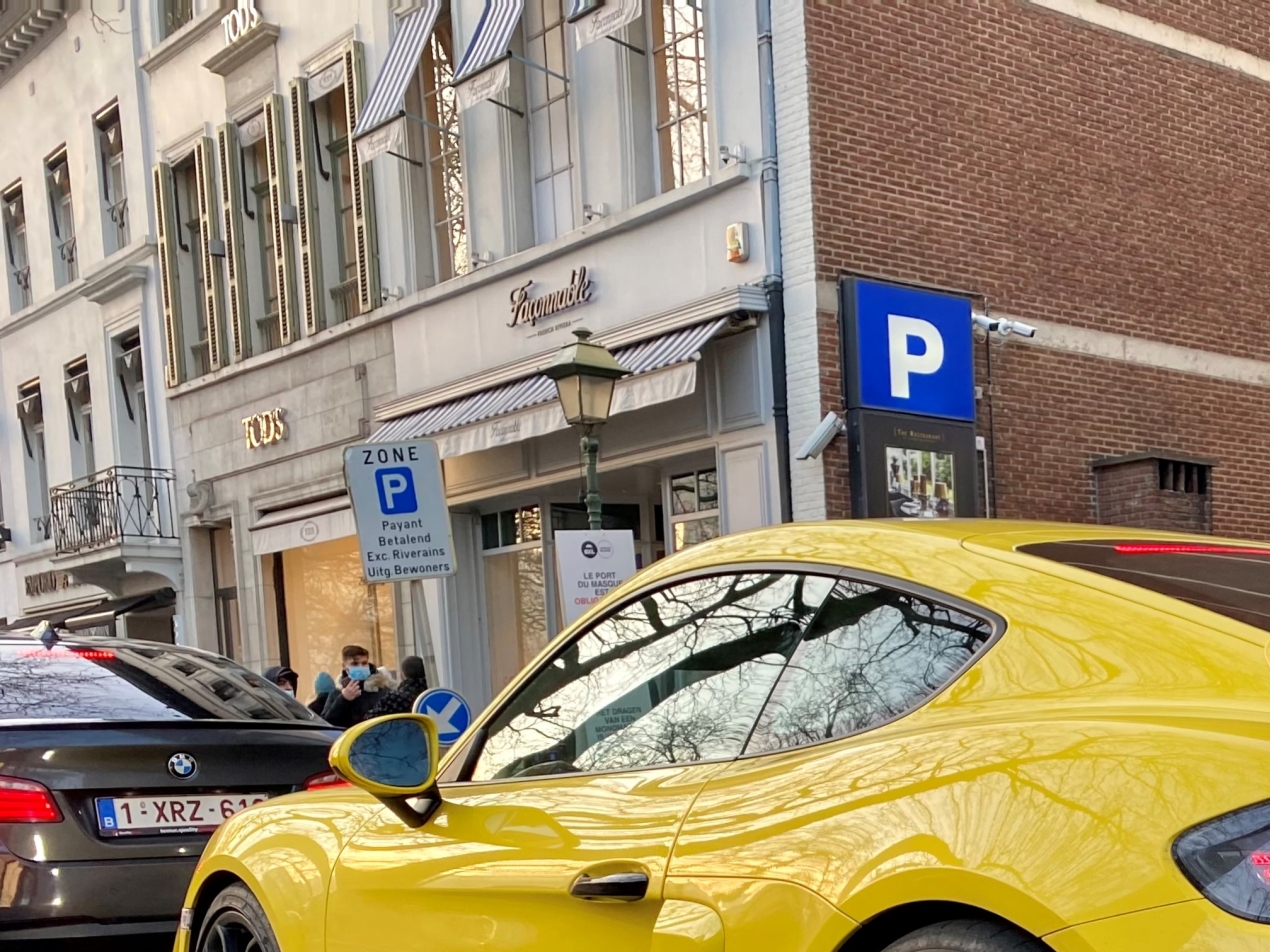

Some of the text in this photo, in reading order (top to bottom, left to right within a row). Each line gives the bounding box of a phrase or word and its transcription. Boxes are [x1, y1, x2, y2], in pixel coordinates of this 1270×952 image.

[887, 314, 944, 399] P
[362, 446, 419, 465] ZONE
[381, 473, 408, 510] P
[382, 518, 423, 532] Payant
[378, 533, 431, 547] Betalend
[367, 547, 445, 562] Exc. Riverains
[583, 571, 616, 580] LE PORT
[577, 580, 589, 588] DU
[103, 816, 115, 828] B
